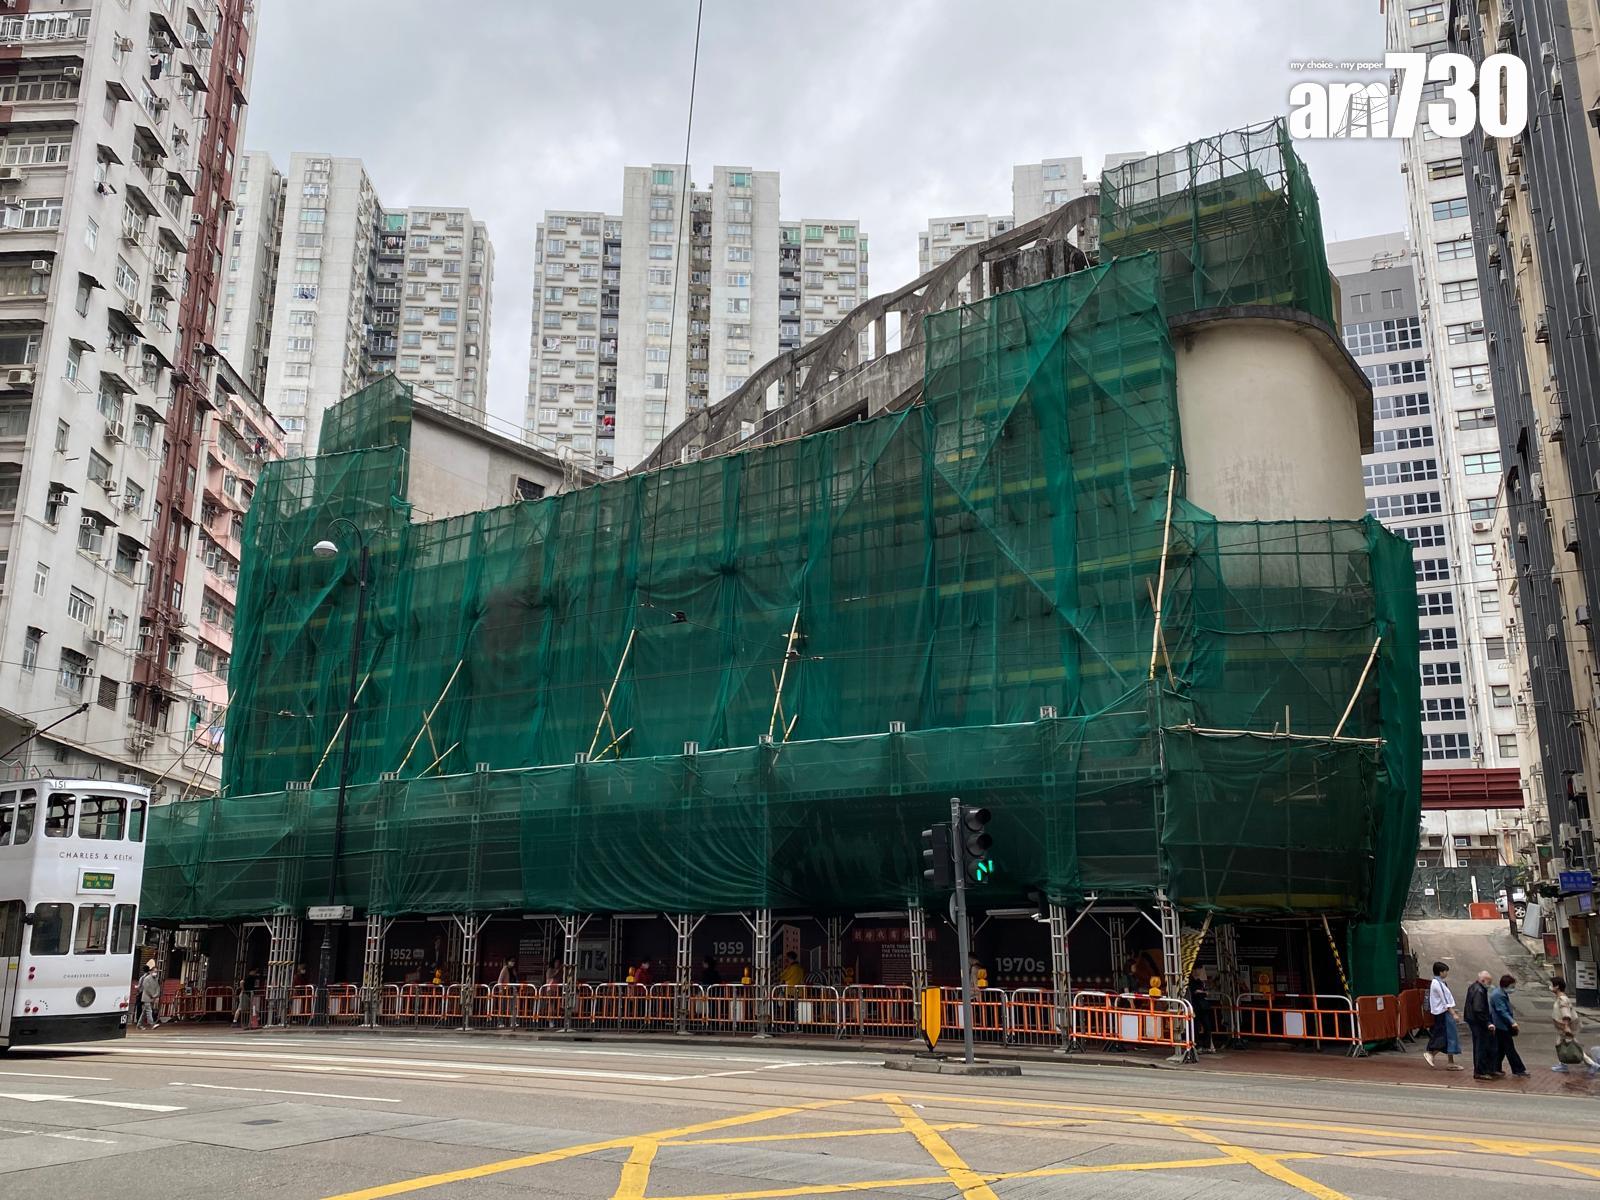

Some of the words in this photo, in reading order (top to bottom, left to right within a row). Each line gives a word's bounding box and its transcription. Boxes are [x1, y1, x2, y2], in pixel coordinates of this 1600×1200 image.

[59, 851, 99, 859] CHARLES
[389, 948, 412, 960] 1952
[713, 941, 744, 955] 1959
[995, 957, 1046, 973] 1970s
